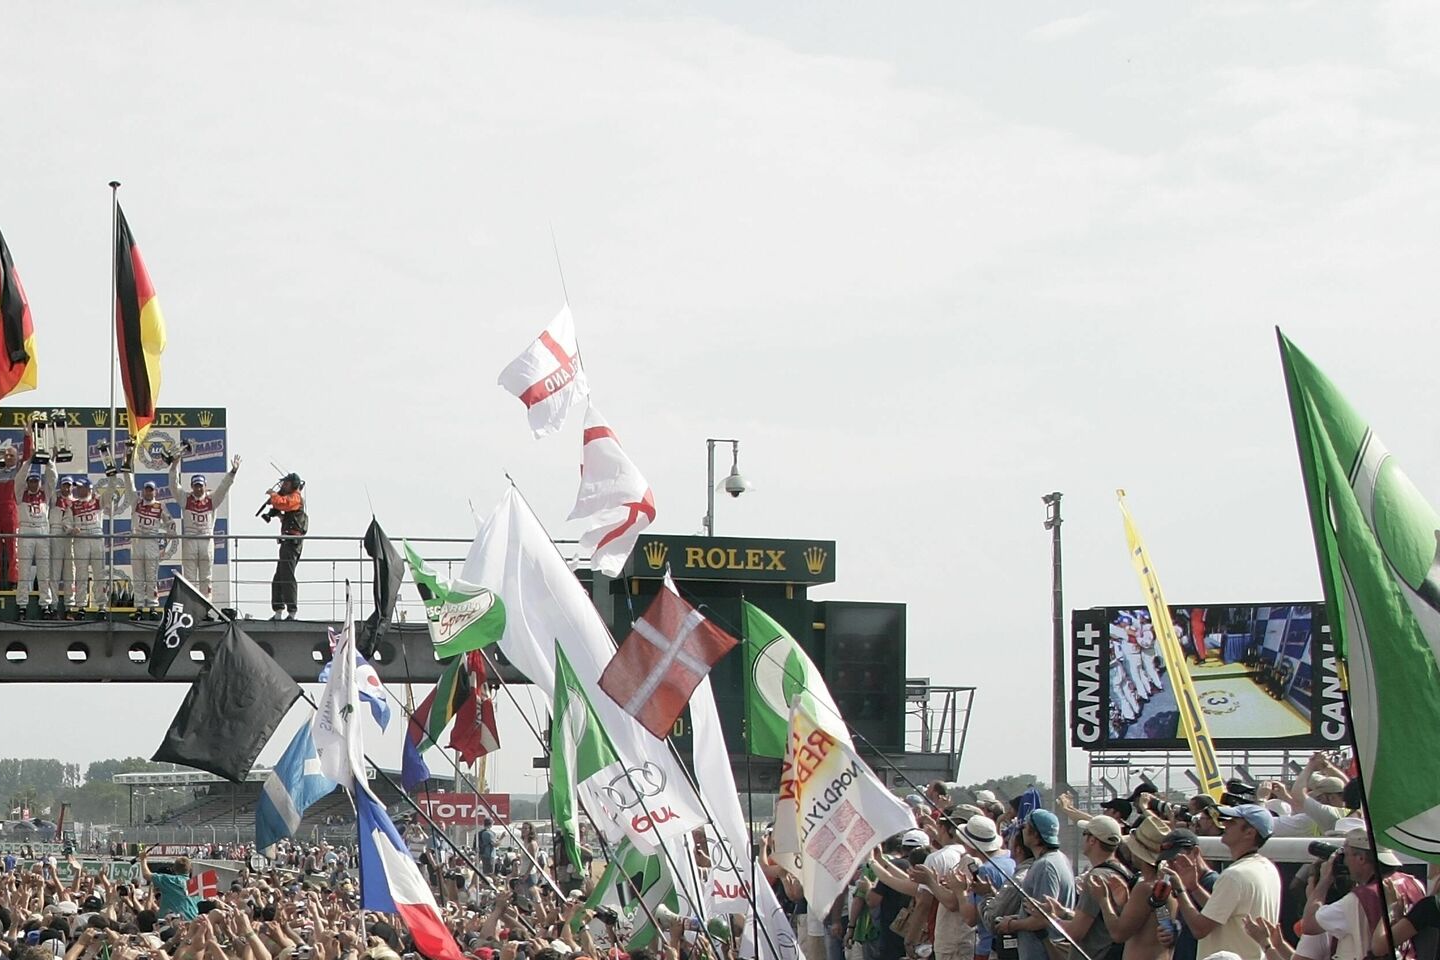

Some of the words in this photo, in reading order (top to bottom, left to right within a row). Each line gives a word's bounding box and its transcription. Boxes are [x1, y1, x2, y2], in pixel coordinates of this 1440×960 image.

[137, 516, 156, 526] TDI
[191, 512, 209, 522] TDI
[685, 547, 786, 571] ROLEX
[1077, 623, 1101, 743] CANAL+
[420, 800, 507, 819] TOTAL
[712, 879, 752, 899] Aud
